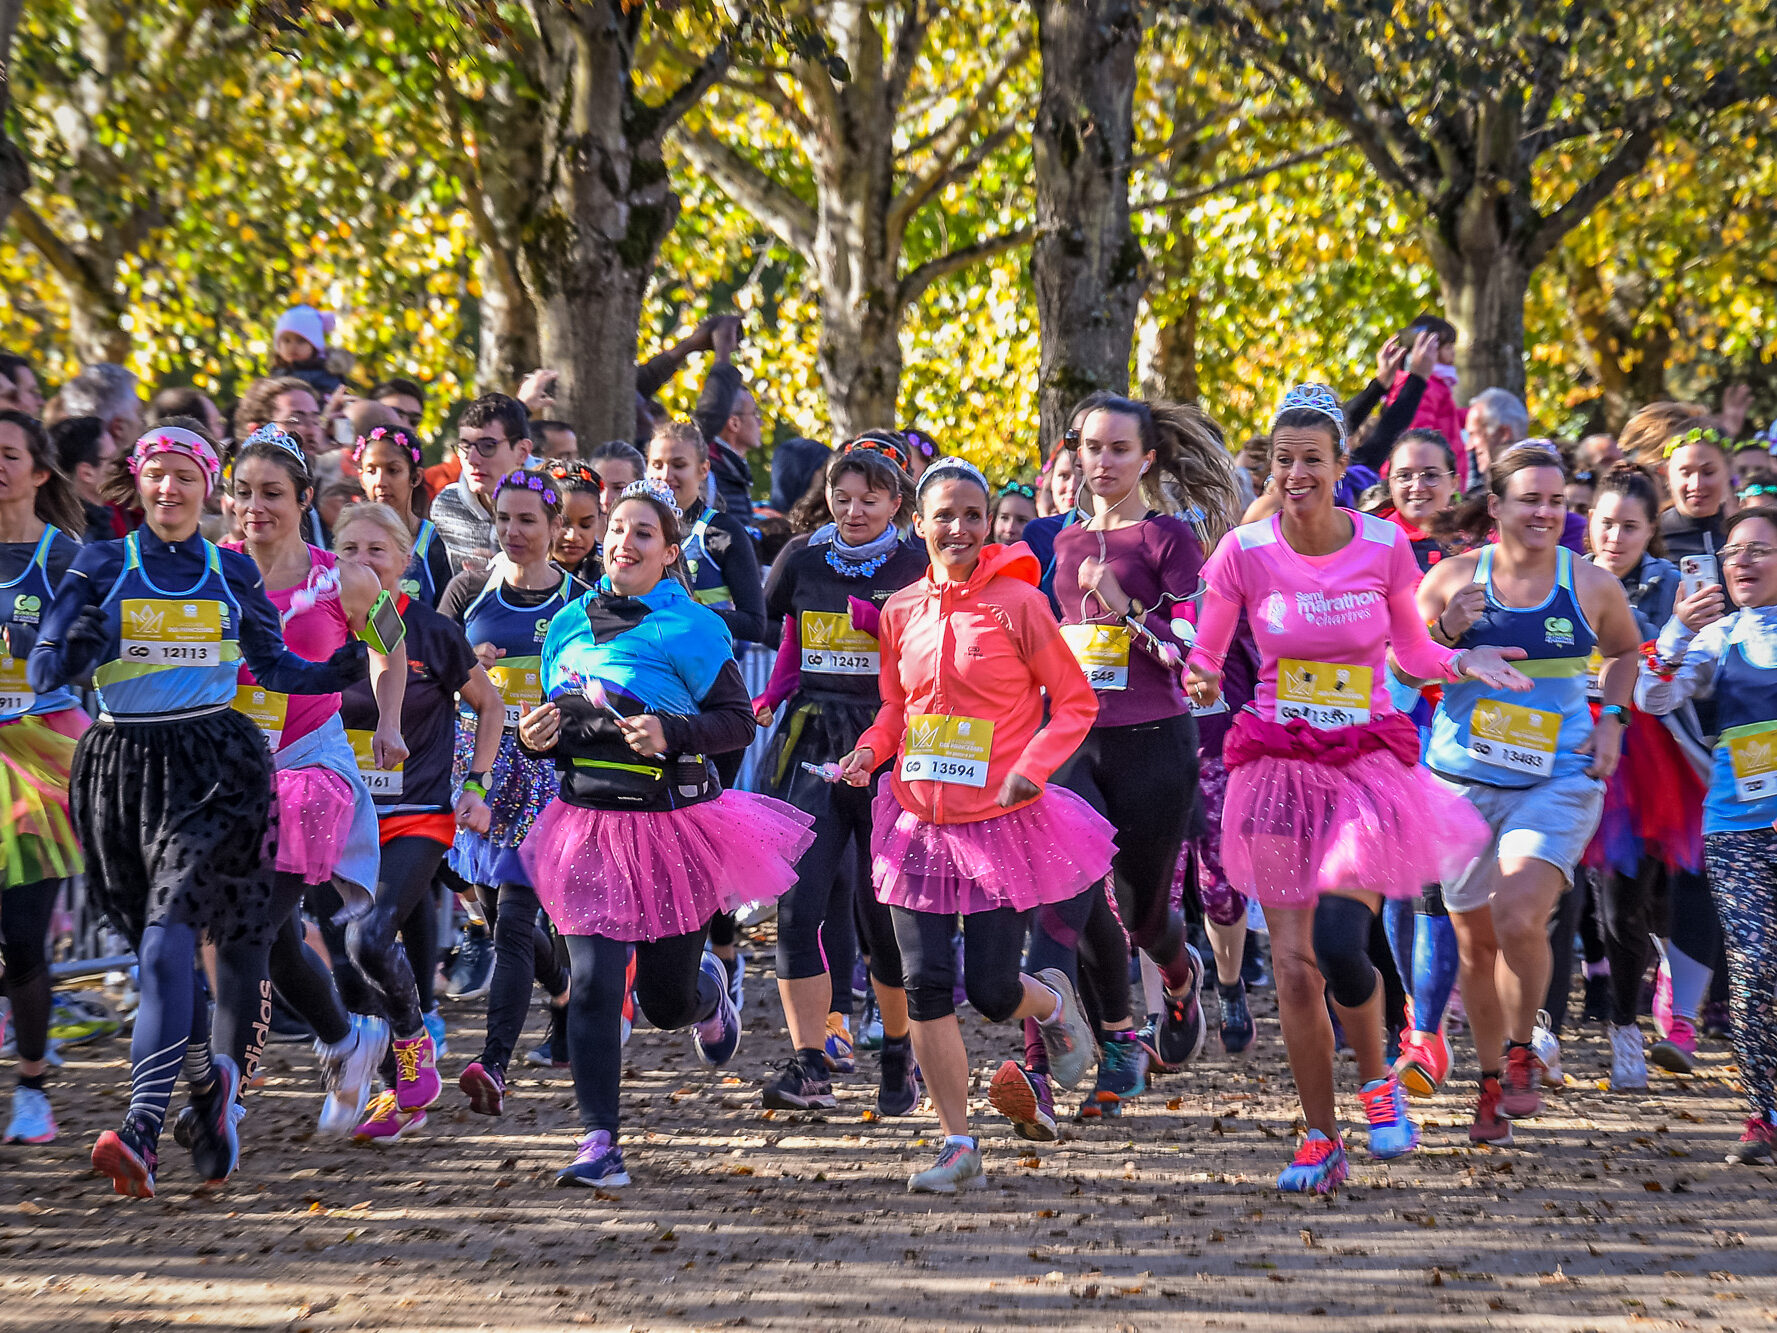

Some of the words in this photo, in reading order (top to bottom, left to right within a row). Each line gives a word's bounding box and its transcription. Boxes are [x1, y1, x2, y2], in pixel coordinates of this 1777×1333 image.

[14, 594, 42, 612] GO
[1298, 592, 1381, 616] marathon
[535, 618, 549, 633] G
[1544, 617, 1574, 633] GO
[162, 647, 208, 659] 12113
[833, 655, 870, 668] 12472
[932, 760, 975, 777] 13594
[238, 979, 272, 1099] adidas
